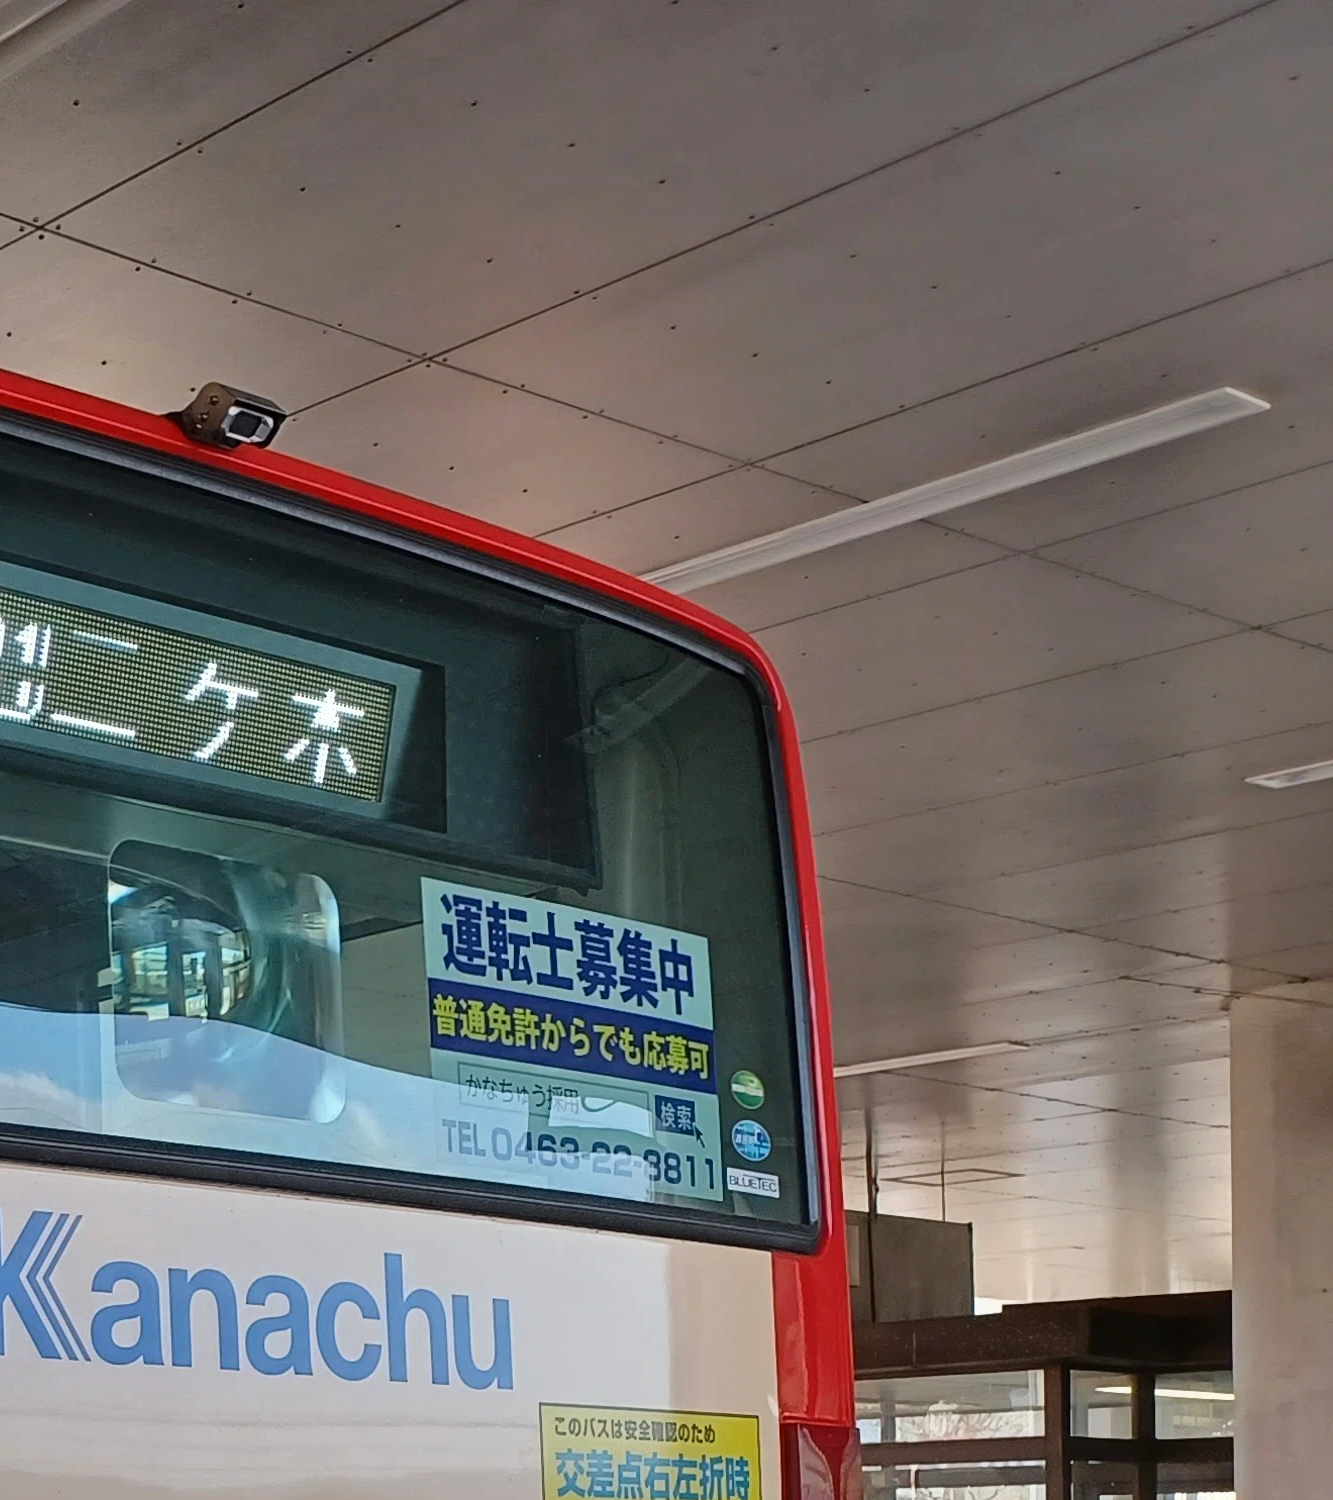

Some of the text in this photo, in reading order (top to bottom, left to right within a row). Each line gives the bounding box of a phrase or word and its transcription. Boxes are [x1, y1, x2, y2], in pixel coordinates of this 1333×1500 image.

[440, 893, 694, 1015] 運転士募集中
[433, 994, 709, 1079] 普通免許からでも応募可
[466, 1075, 692, 1131] かなちゅう採用 検索
[441, 1119, 716, 1189] TEL 0463-22-8811
[729, 1174, 777, 1192] BLUETEC
[555, 1417, 716, 1443] このバスは安全確認のため
